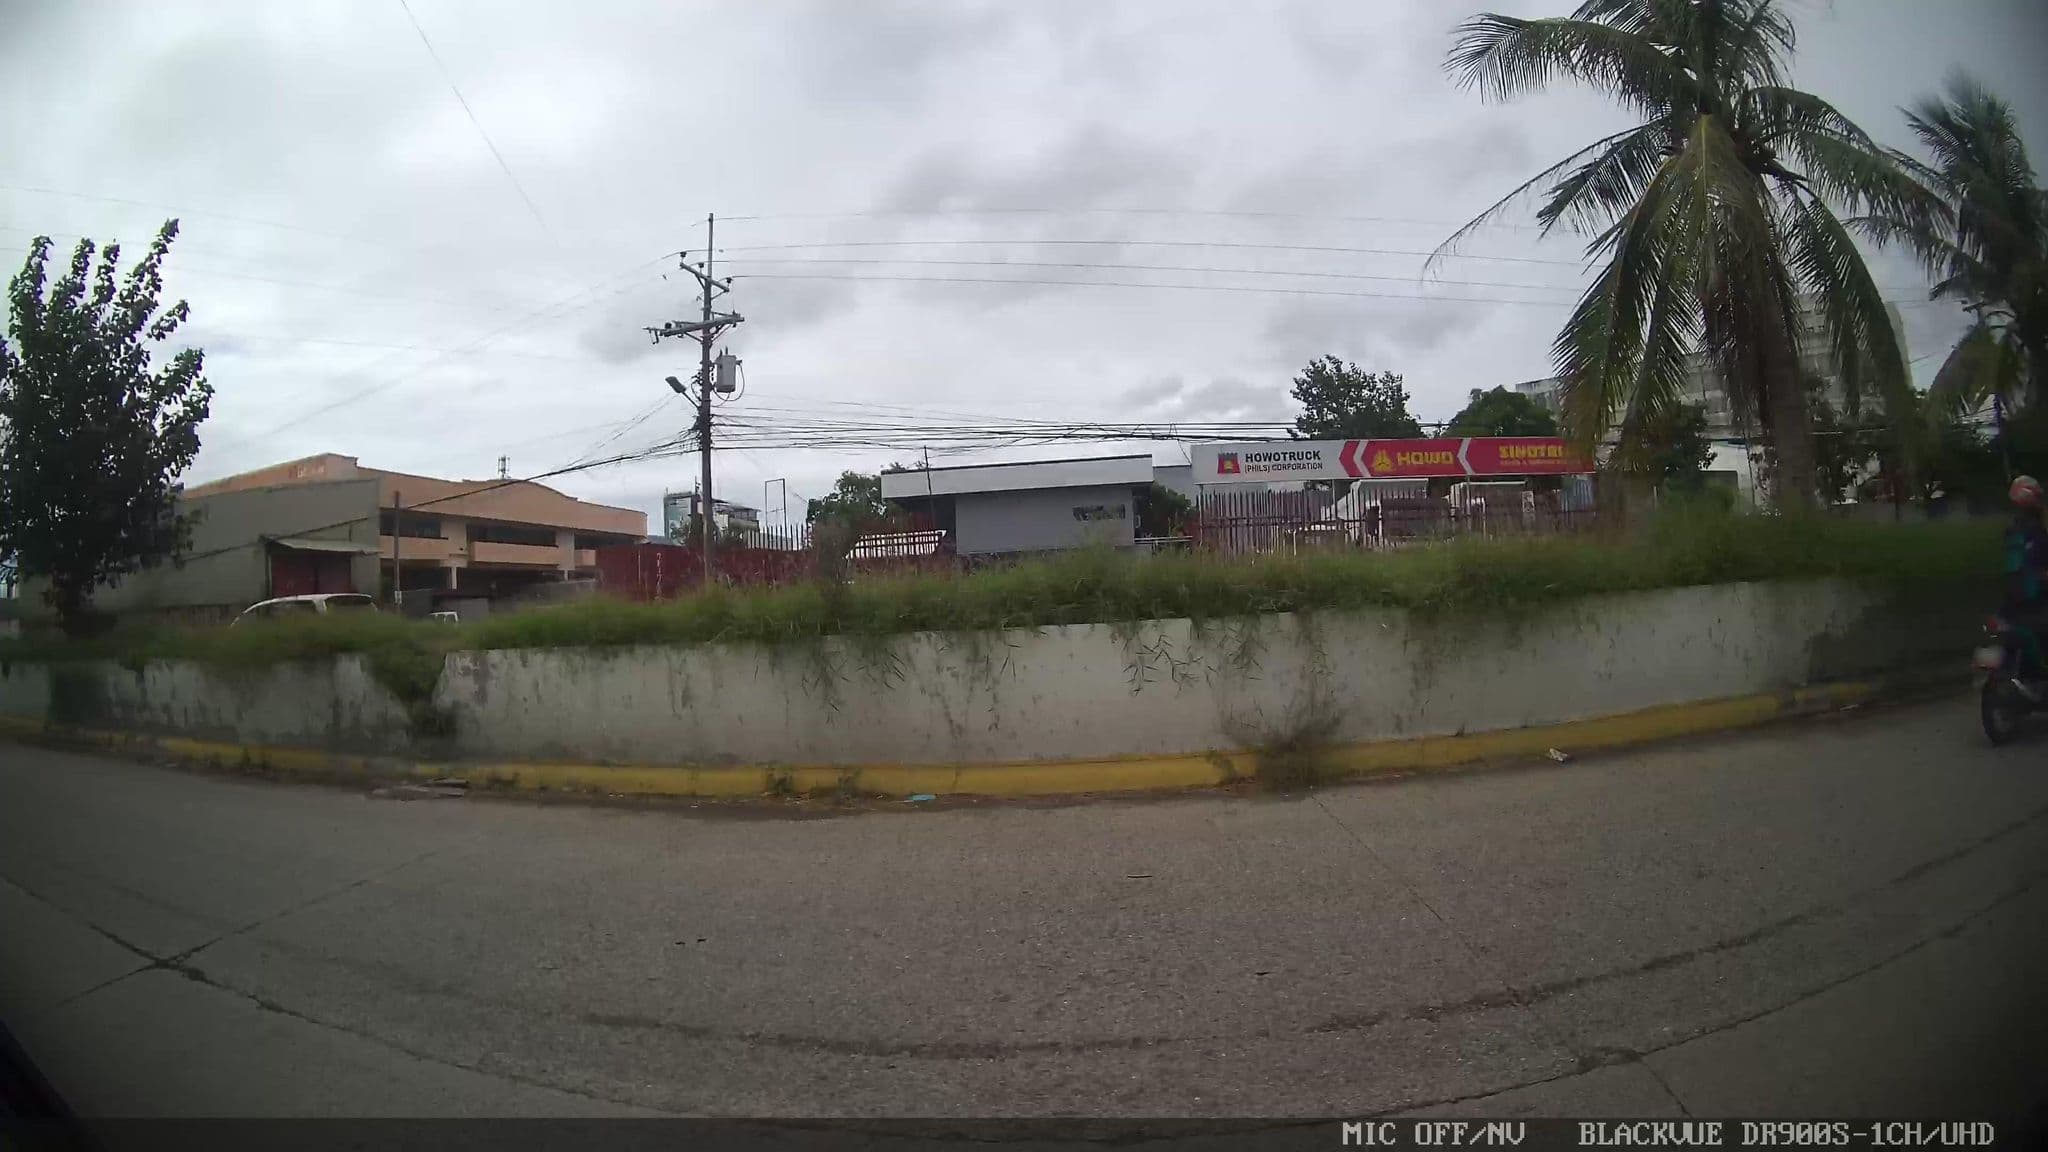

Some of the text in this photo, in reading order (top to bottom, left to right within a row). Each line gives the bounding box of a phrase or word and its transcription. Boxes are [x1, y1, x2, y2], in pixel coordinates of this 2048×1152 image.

[1245, 450, 1321, 462] HOWOTRUCK
[1397, 451, 1454, 465] HOWO
[1244, 462, 1323, 473] (PHILS) CORPORATION
